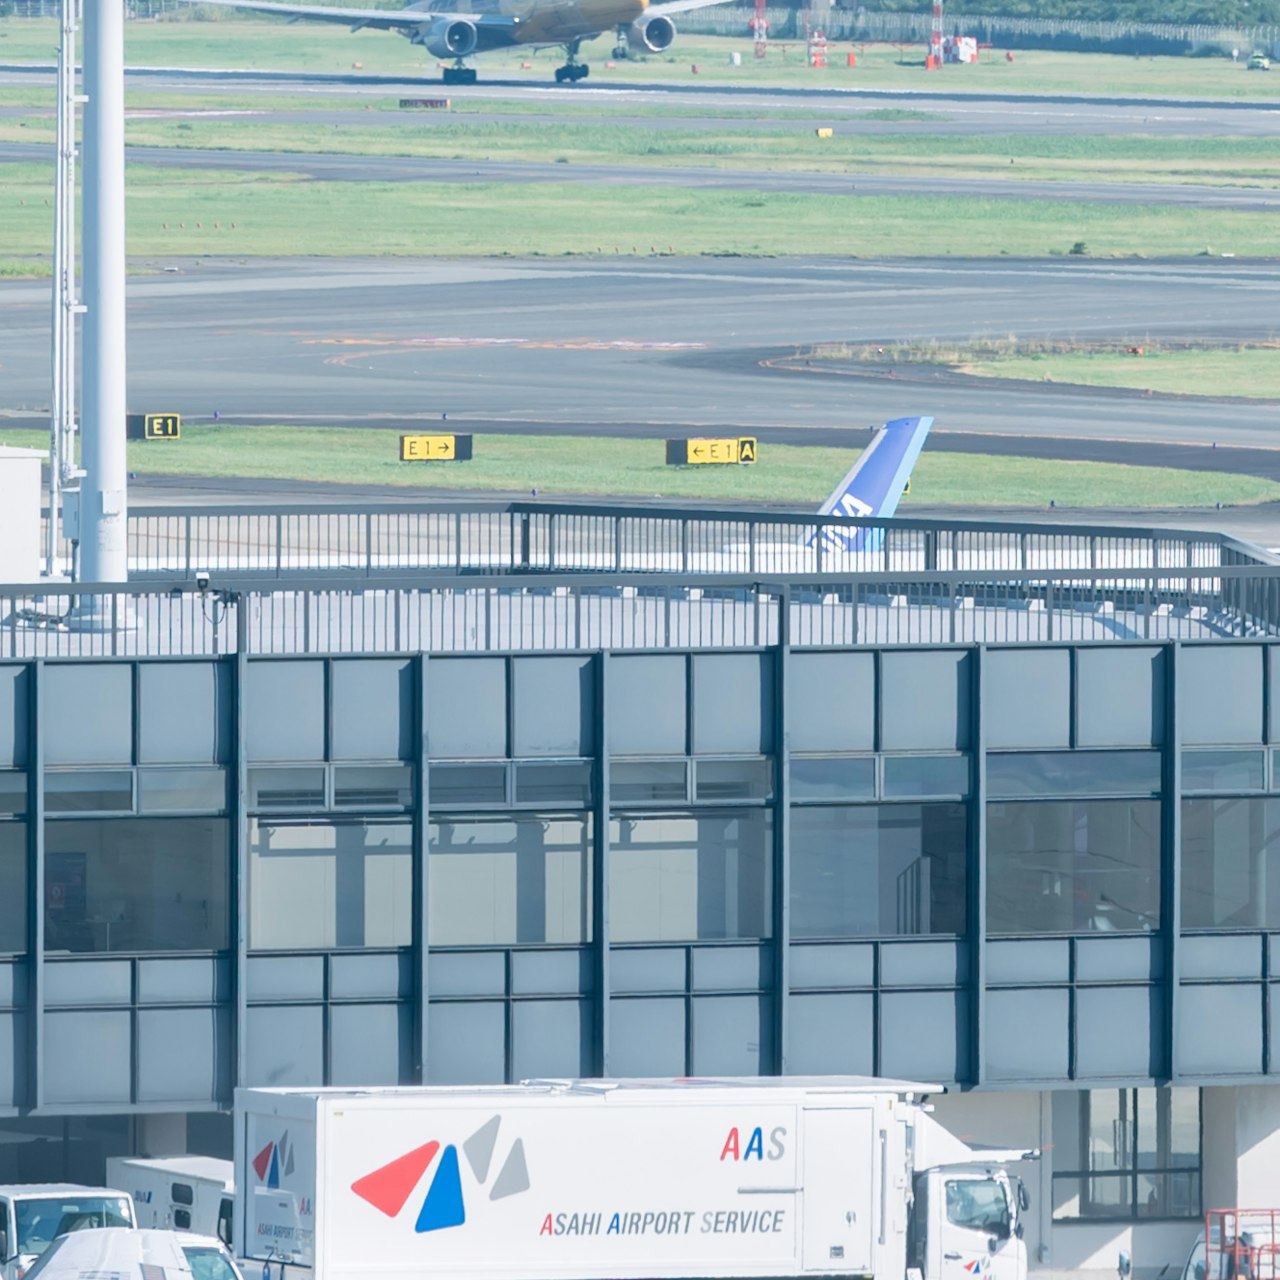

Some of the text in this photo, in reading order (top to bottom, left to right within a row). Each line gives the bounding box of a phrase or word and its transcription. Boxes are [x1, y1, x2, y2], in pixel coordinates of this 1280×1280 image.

[153, 418, 173, 434] E1
[409, 441, 430, 455] E1
[710, 443, 754, 459] E1 A
[720, 1126, 787, 1161] AAS
[540, 1210, 785, 1235] ASAHI AIRPORT SERVICE
